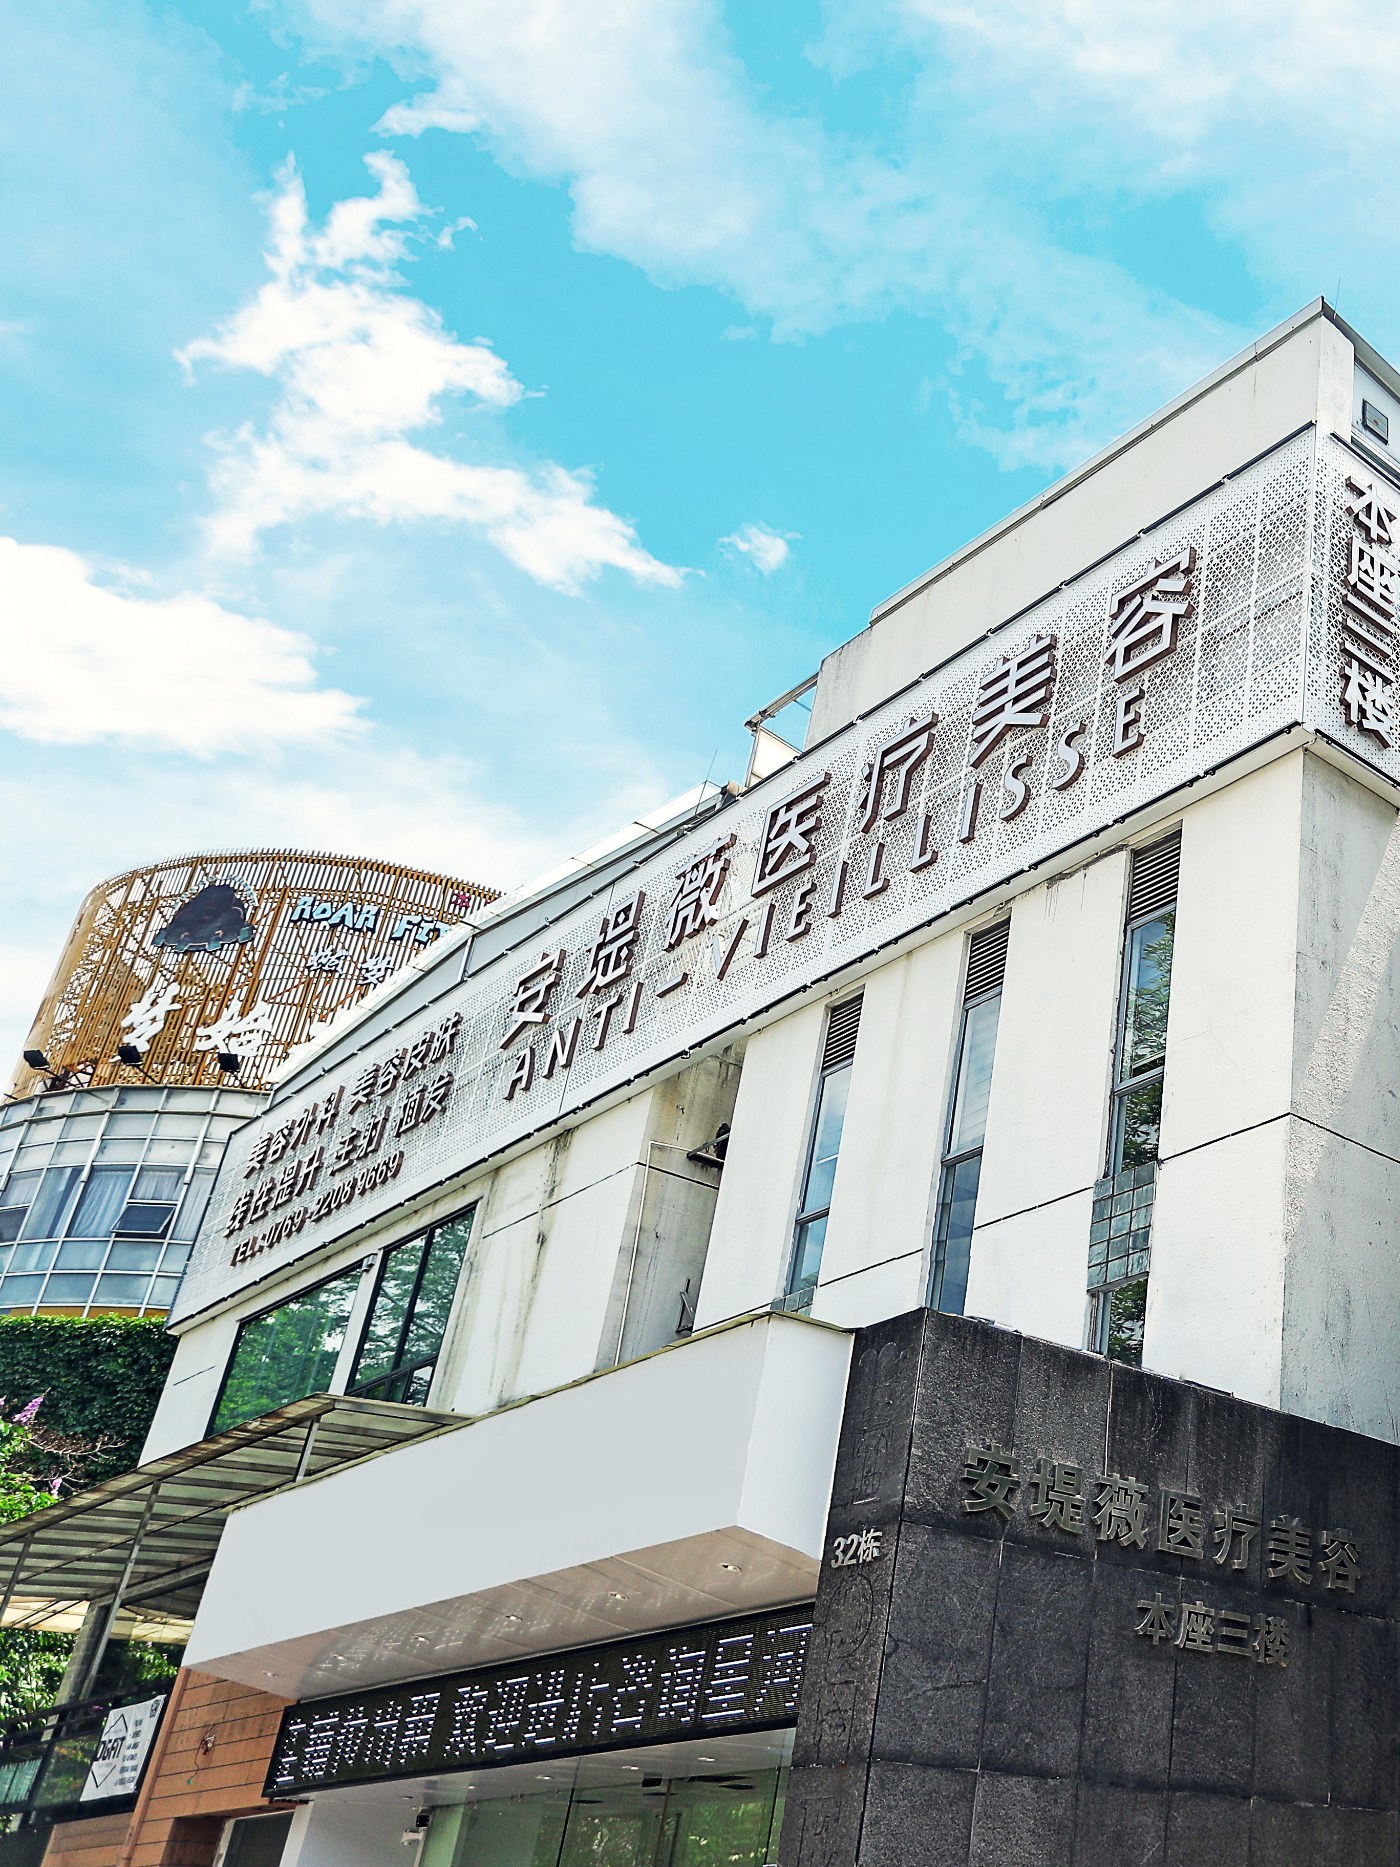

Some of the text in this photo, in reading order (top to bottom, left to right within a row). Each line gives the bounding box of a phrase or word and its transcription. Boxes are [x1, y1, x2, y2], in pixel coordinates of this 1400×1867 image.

[1339, 475, 1399, 750] 本座三楼
[499, 545, 1197, 1049] 安堤薇医疗美容
[290, 896, 381, 933] ROAR
[503, 686, 1146, 1101] ANTI-VIEILLISSE
[244, 1012, 463, 1179] 美容外科 美容皮肤
[830, 1528, 883, 1569] 32栋
[961, 1443, 1361, 1594] 安堤薇医疗美容
[1134, 1592, 1289, 1668] 本座三楼
